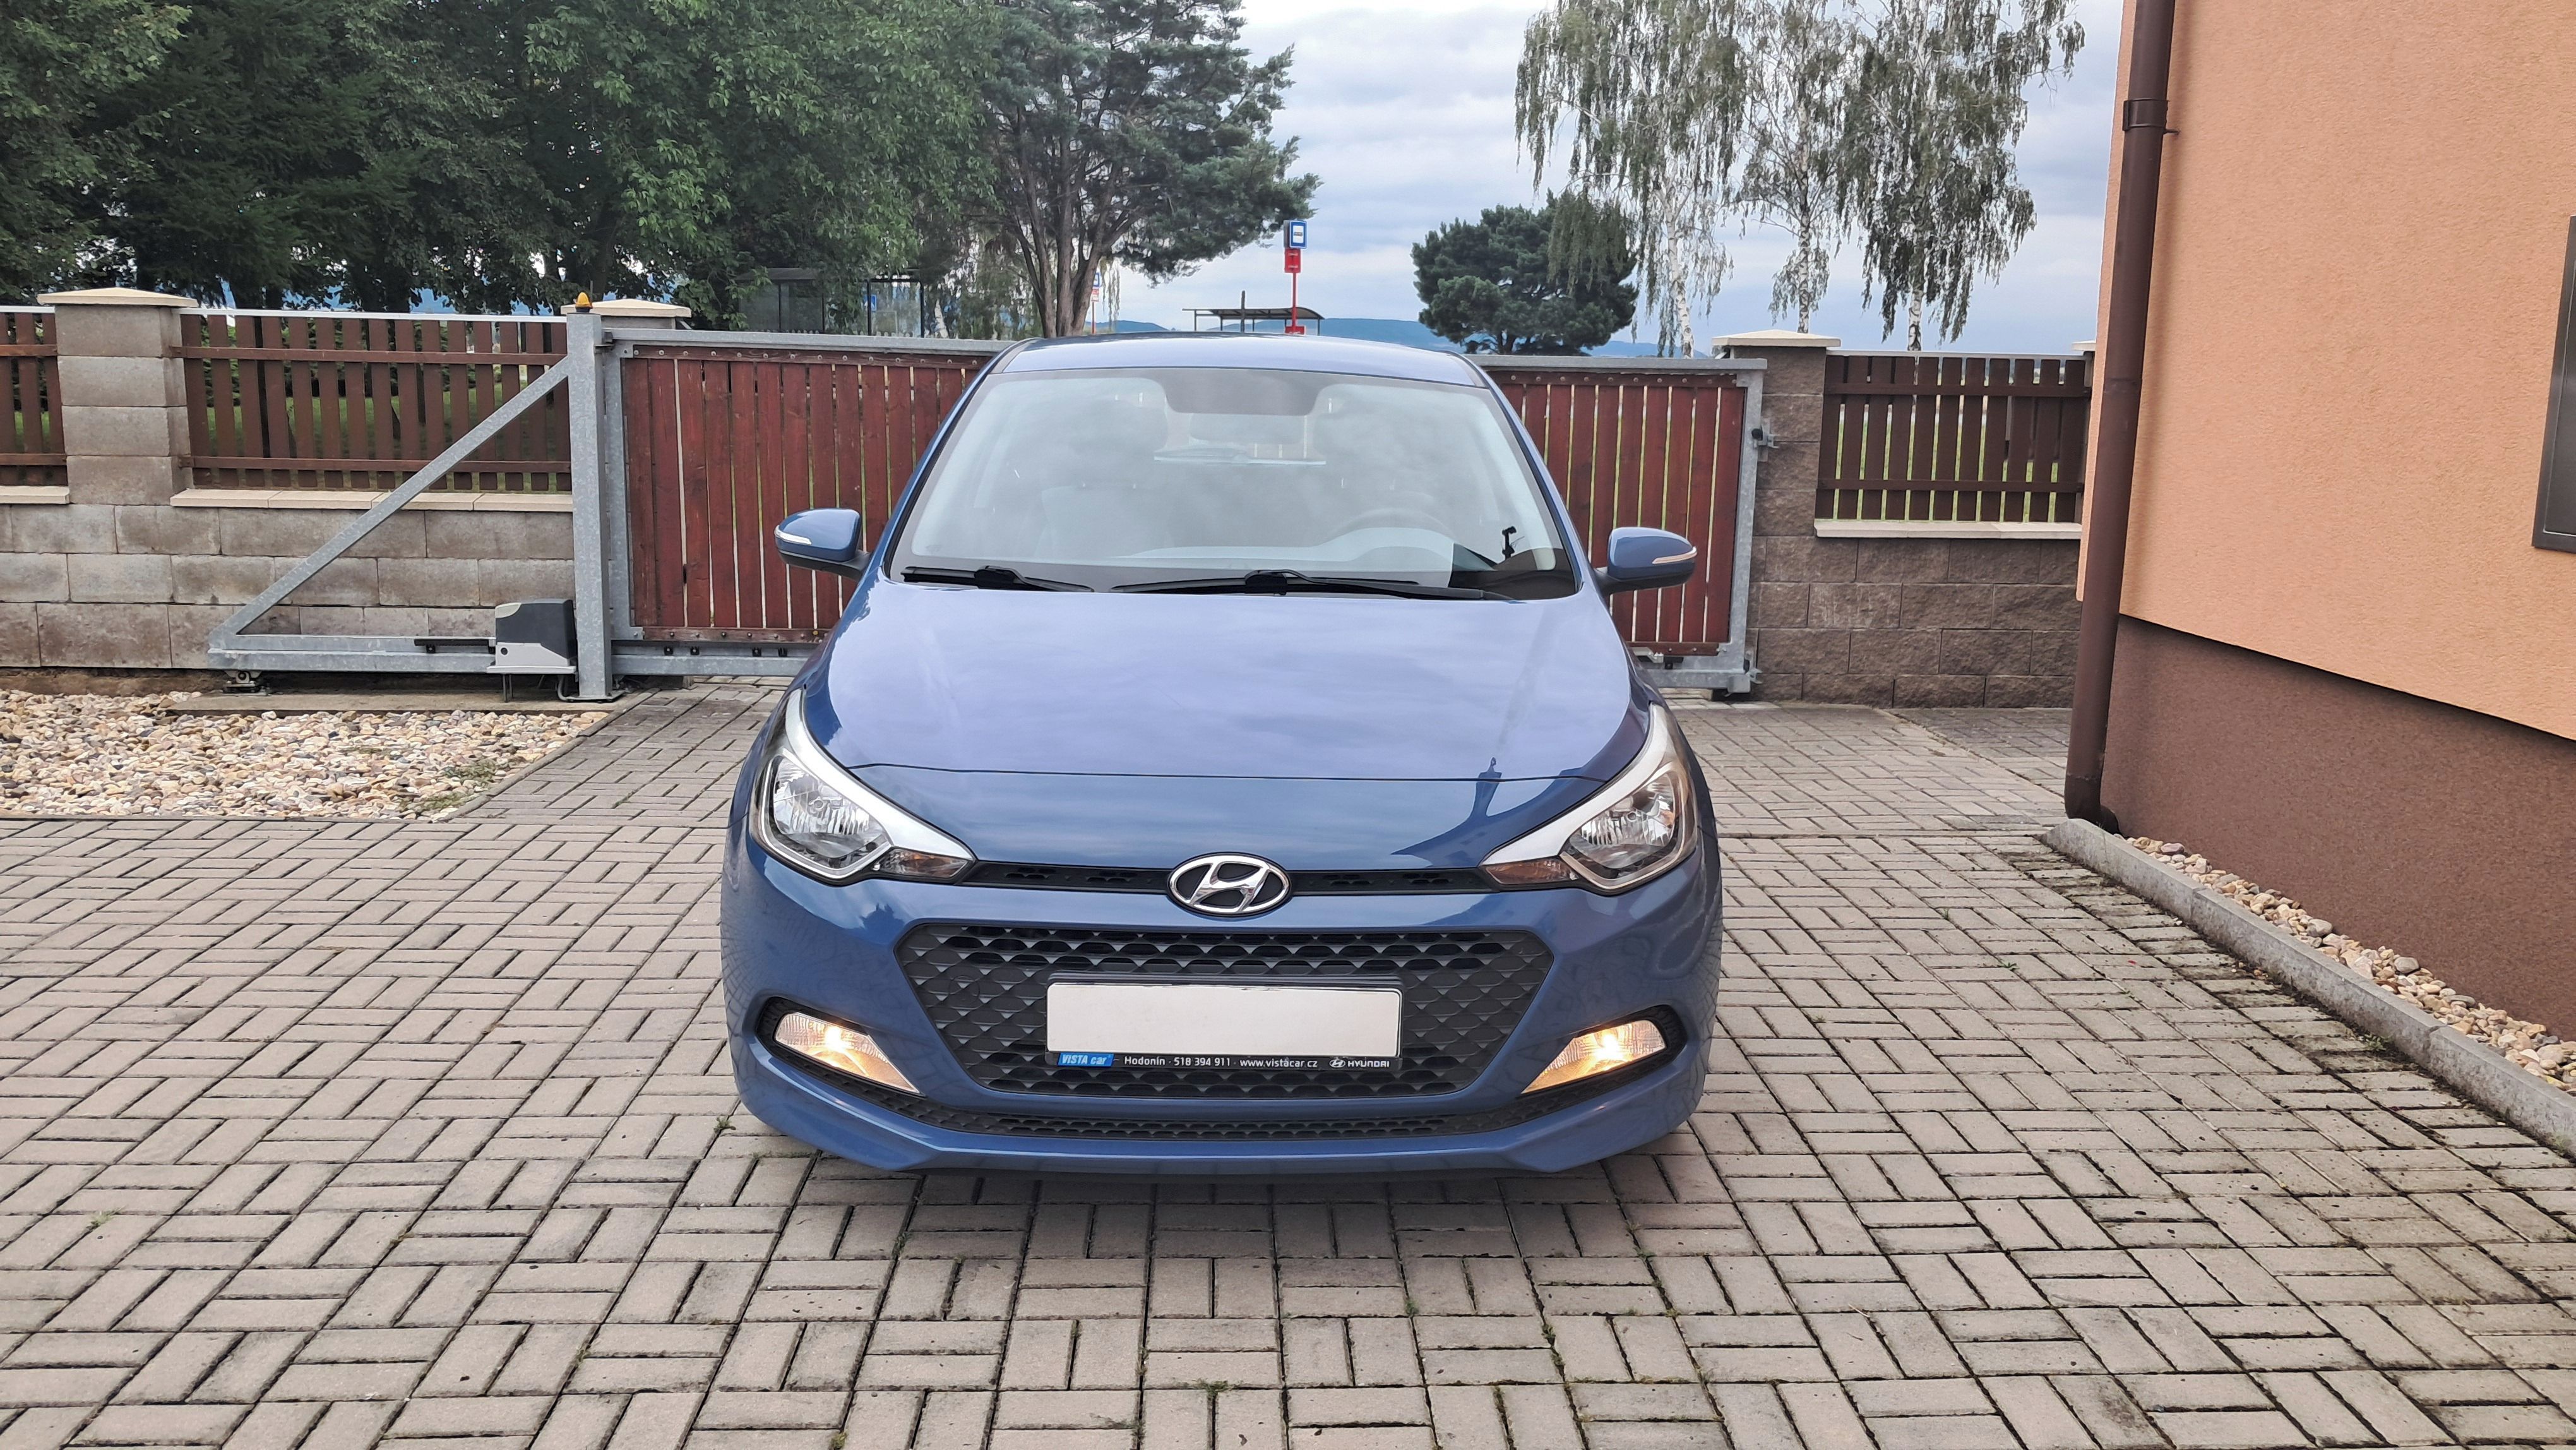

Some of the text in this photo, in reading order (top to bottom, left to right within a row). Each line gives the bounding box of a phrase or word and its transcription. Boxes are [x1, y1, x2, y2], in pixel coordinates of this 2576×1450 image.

[1062, 1054, 1107, 1065] VISTA car
[1124, 1057, 1166, 1065] Hodonín
[1174, 1057, 1191, 1066] 518
[1194, 1057, 1211, 1066] 394
[1214, 1057, 1231, 1067] 911
